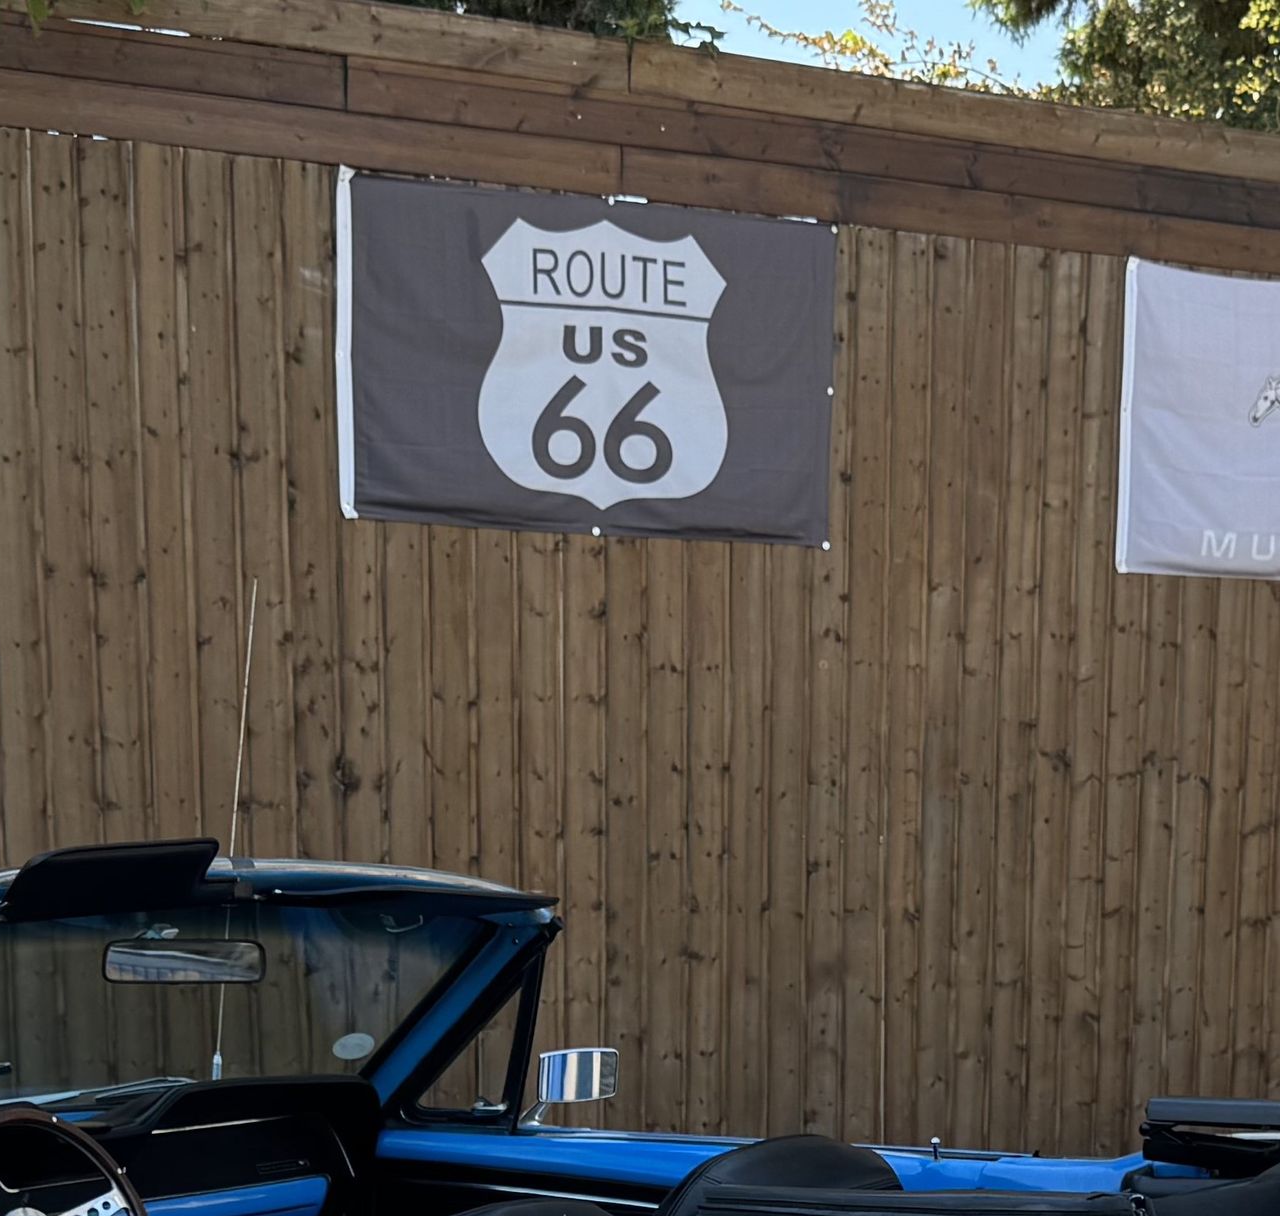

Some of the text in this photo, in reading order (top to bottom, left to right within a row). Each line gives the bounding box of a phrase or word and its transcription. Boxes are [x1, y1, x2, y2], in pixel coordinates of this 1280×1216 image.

[531, 247, 687, 308] ROUTE
[562, 324, 649, 368] US
[532, 374, 673, 484] 66
